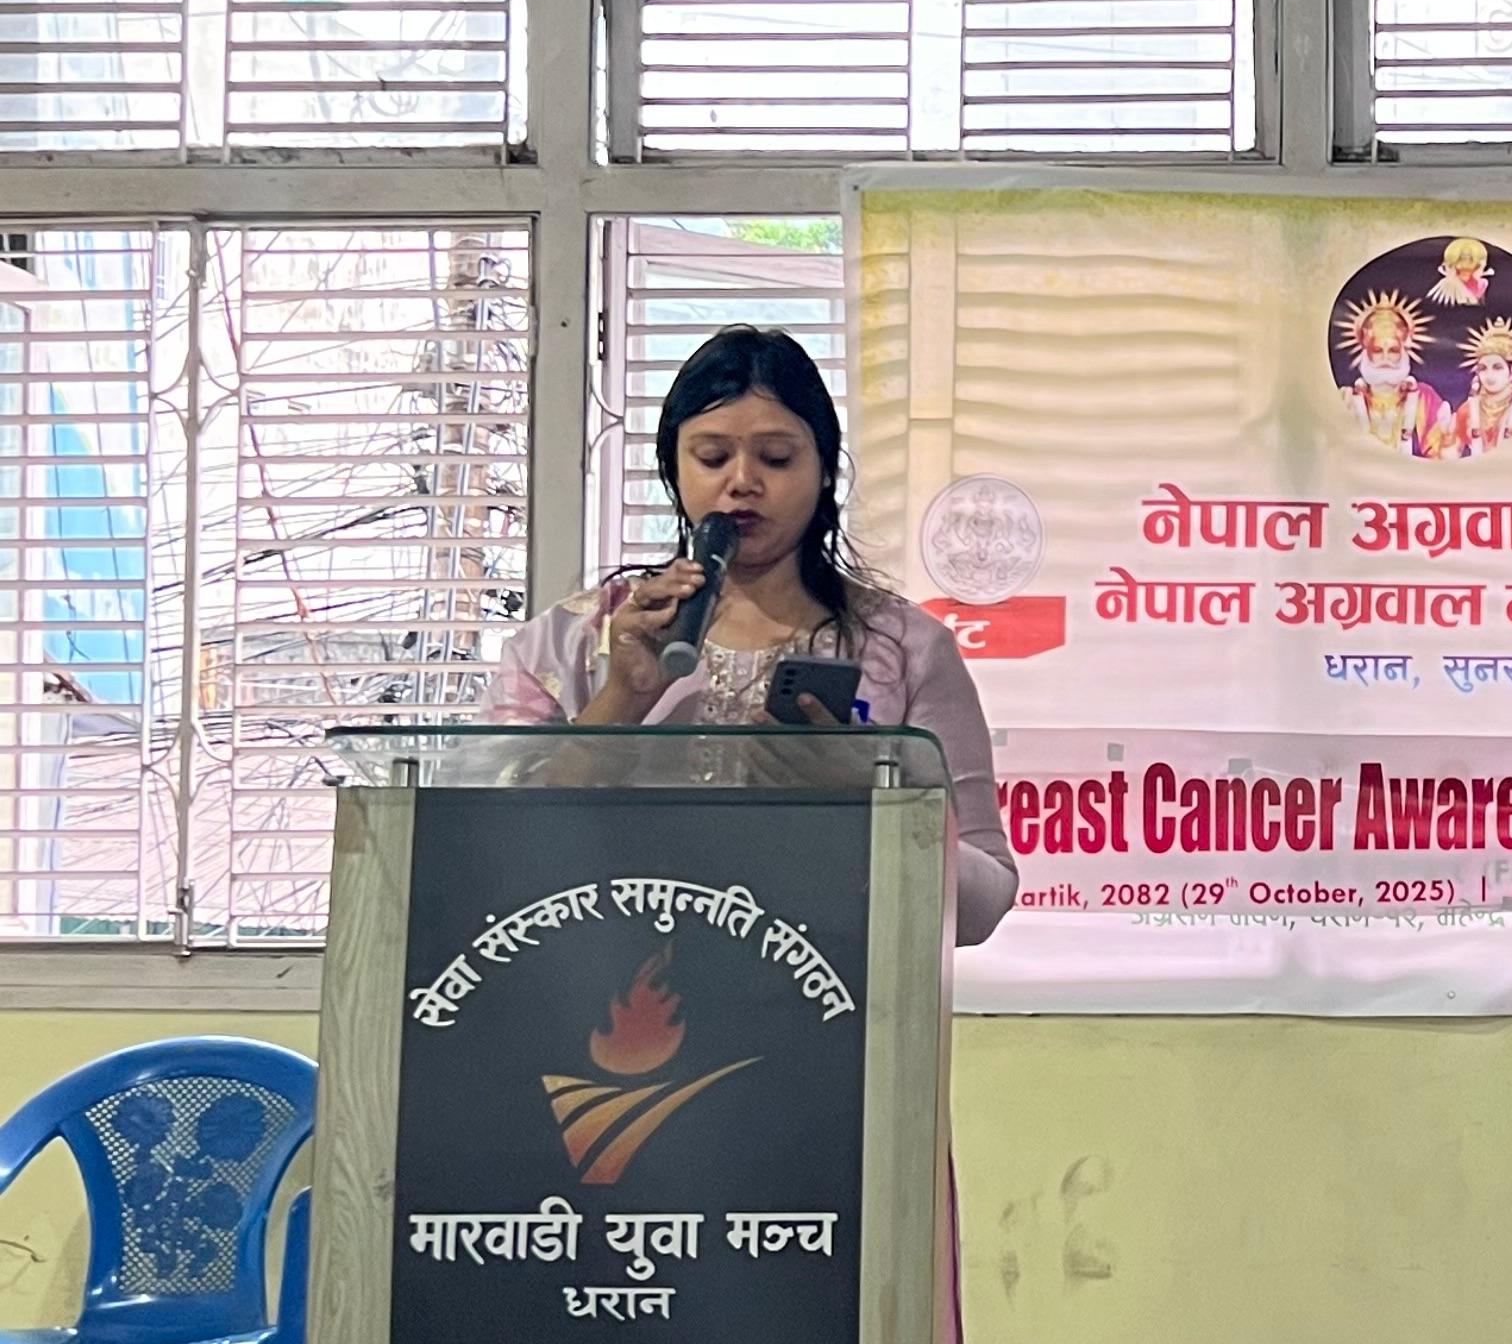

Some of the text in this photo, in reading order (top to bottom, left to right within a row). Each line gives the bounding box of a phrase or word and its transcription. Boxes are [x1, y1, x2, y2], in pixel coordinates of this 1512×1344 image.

[1141, 483, 1329, 551] नेपाल
[1095, 566, 1256, 626] नेपाल
[1275, 582, 1487, 630] अग्रवाल
[1324, 654, 1420, 690] धरान,
[998, 771, 1129, 855] east
[1143, 762, 1342, 854] Cancer
[1013, 883, 1089, 911] artik,
[1101, 882, 1171, 907] 2082
[1181, 876, 1239, 909] (29th
[1249, 881, 1364, 908] October,
[1375, 878, 1456, 905] 2025)
[409, 877, 856, 1028] सेवा संस्कार समुन्नति संगठन
[409, 1196, 839, 1281] मारवाडी युवा मञ्च
[562, 1286, 676, 1321] धरान
